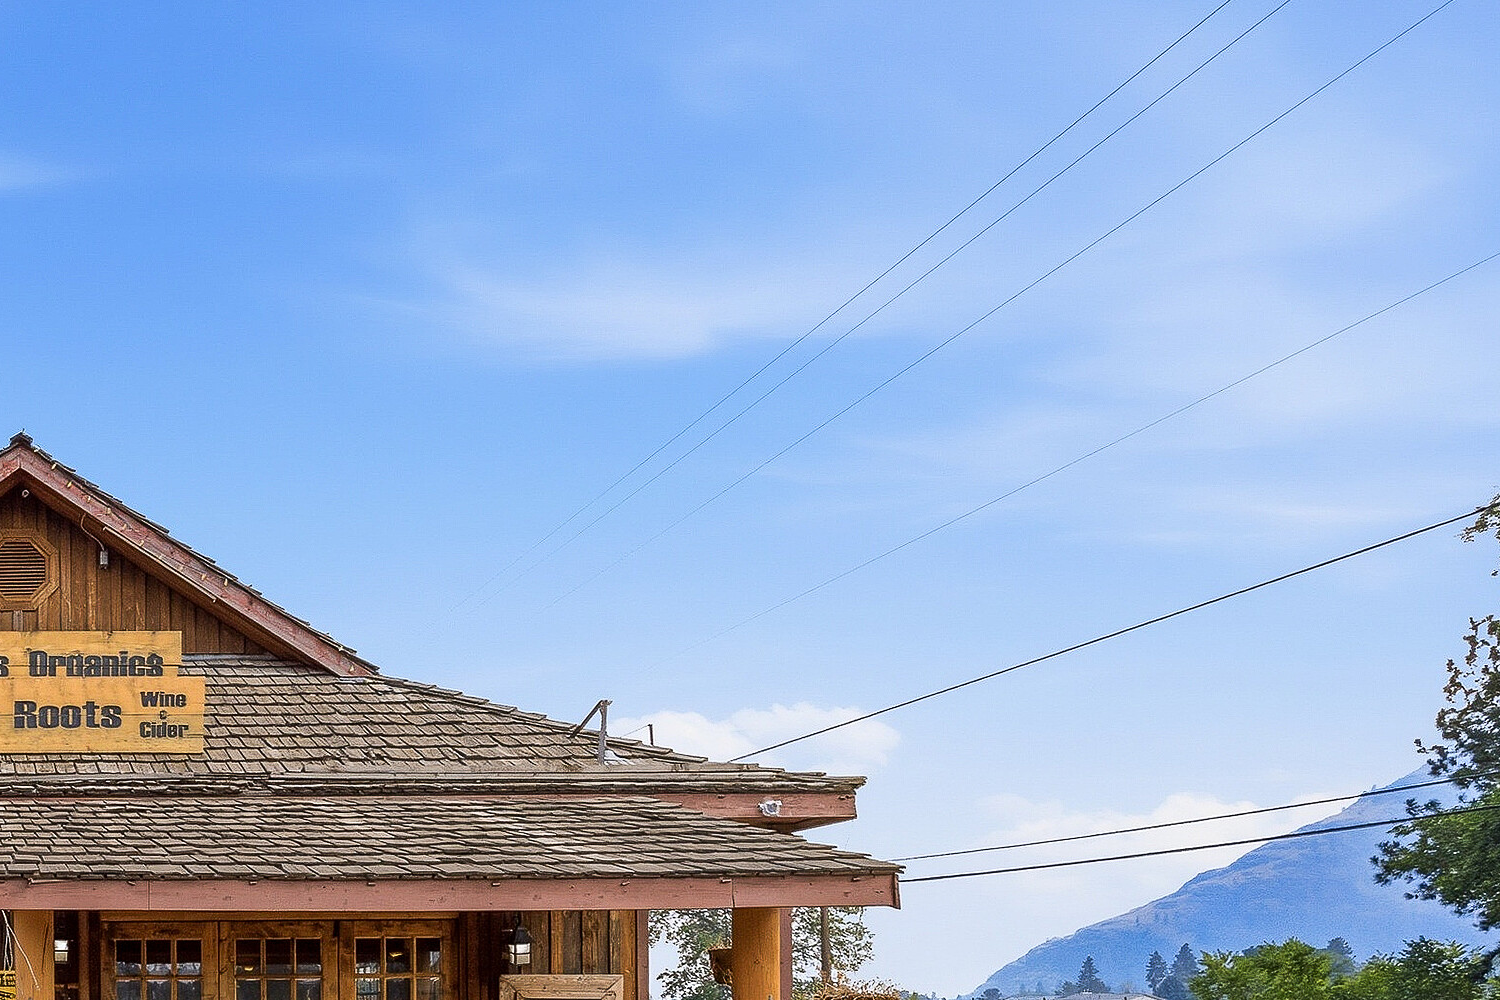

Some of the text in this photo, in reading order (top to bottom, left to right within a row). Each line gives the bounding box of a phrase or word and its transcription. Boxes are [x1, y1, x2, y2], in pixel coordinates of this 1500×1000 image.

[140, 691, 187, 707] Wine
[14, 700, 123, 729] Roots
[140, 721, 189, 738] Cider
